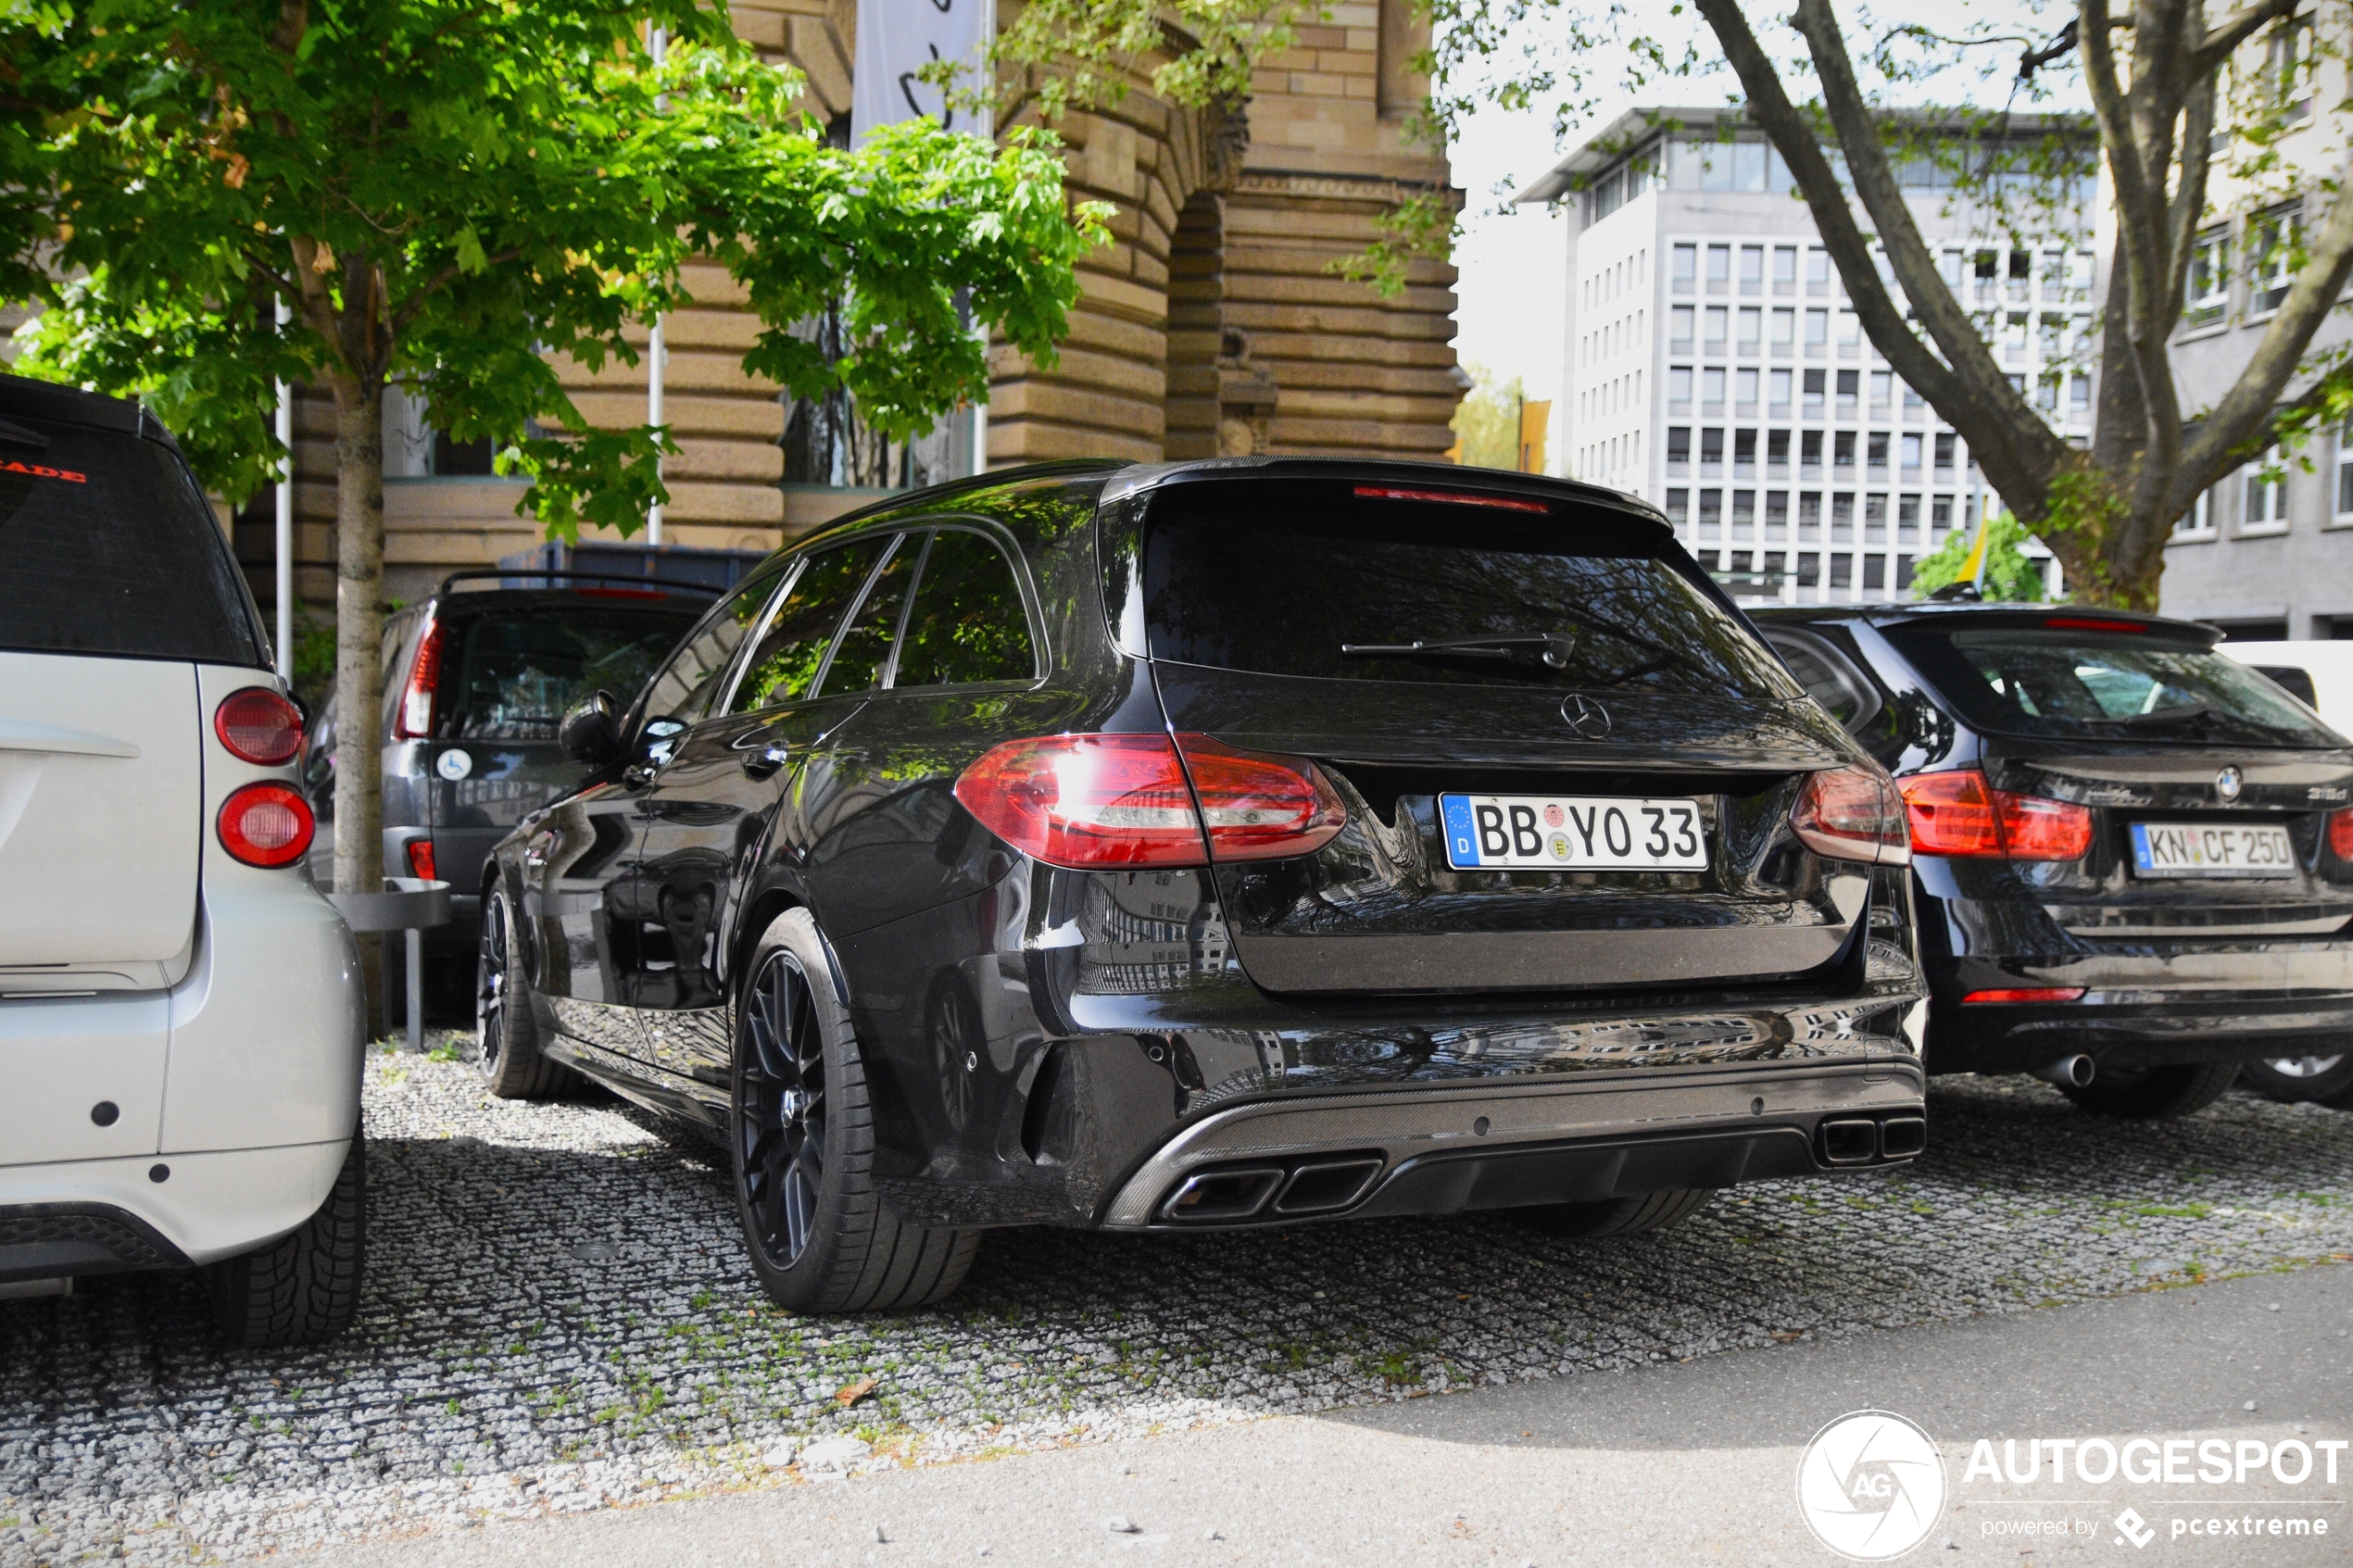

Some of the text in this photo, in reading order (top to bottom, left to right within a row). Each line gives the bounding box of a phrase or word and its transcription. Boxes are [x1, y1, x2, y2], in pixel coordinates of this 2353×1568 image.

[1458, 838, 1469, 854] D
[1476, 805, 1542, 857] BB
[1568, 806, 1631, 858] YO
[1641, 808, 1697, 858] 33
[2148, 830, 2289, 863] KN CF 250
